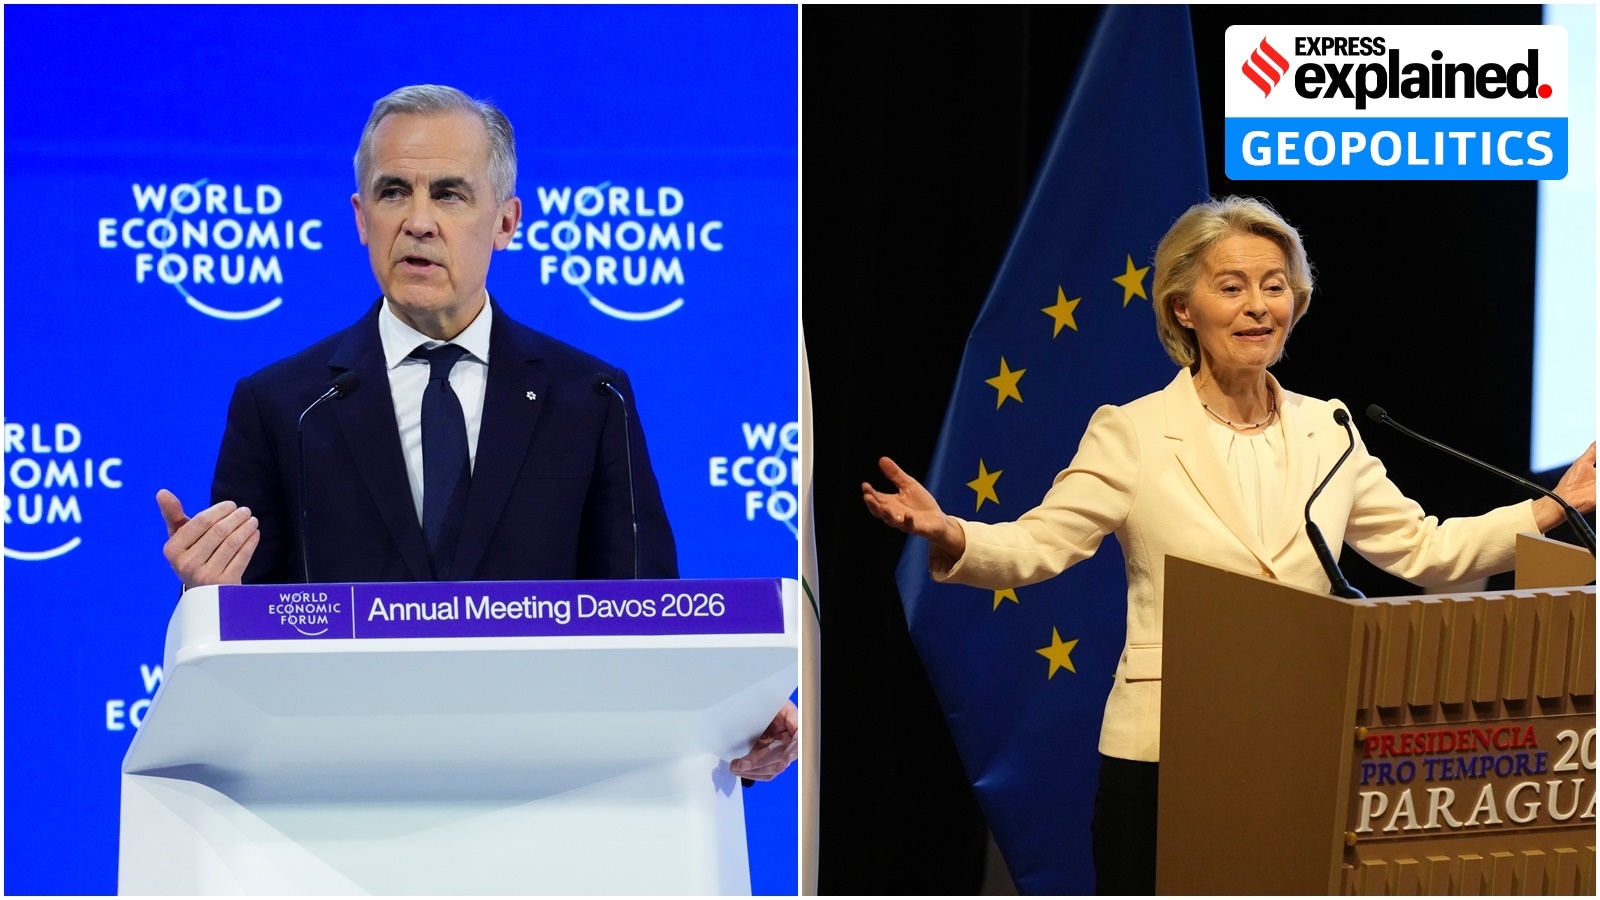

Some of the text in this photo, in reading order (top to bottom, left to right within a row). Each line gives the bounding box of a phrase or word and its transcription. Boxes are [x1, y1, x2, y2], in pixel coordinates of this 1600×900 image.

[132, 183, 282, 214] WORLD
[537, 186, 684, 217] WORLD
[98, 218, 322, 250] ECONOMIC
[135, 253, 283, 284] FORUM
[540, 255, 685, 286] FORUM
[268, 603, 341, 614] ECONOMIC
[279, 592, 328, 603] WORLD
[367, 592, 726, 625] Annual Meeting Davos 2026
[280, 614, 329, 625] FORUM
[1362, 725, 1538, 757] PRESIDENCIA
[1360, 750, 1549, 785] PRO TEMPORE
